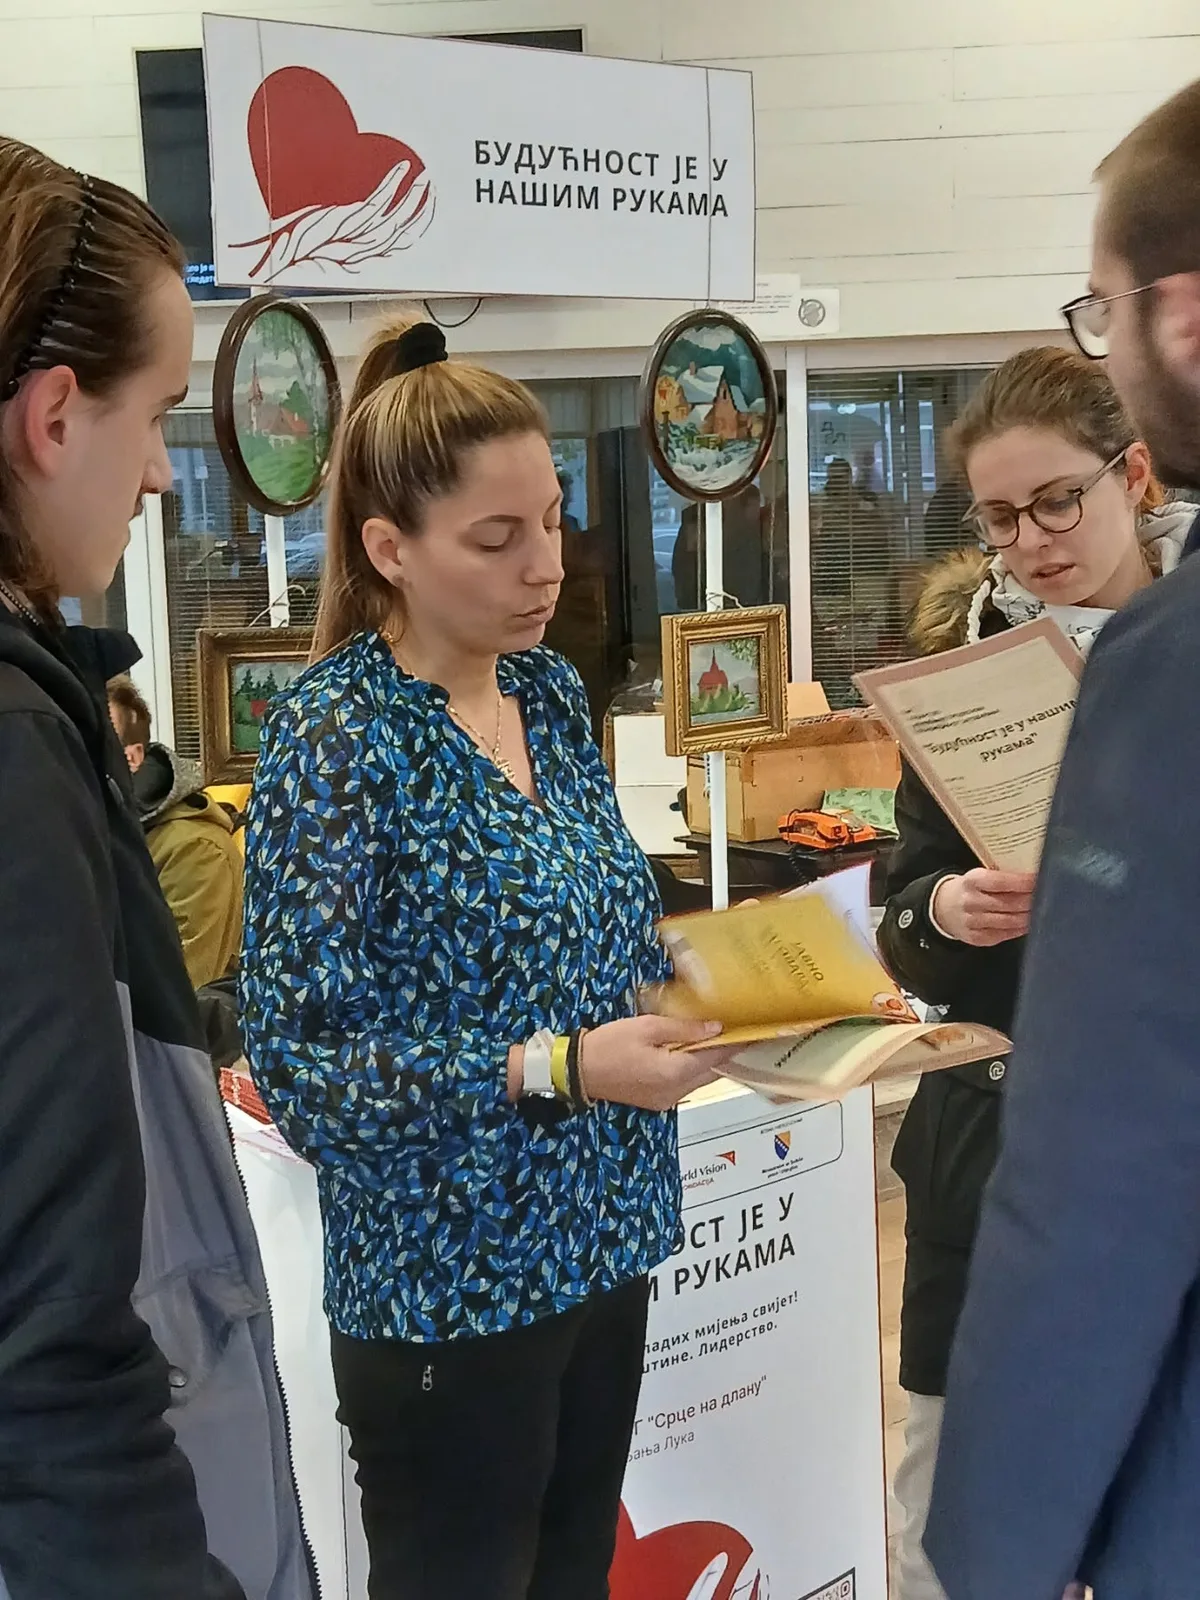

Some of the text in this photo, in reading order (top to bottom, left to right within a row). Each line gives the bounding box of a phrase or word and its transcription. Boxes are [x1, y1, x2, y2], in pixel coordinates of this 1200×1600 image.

[474, 140, 728, 184] БУДУЋНОСТ ЈЕ У
[475, 178, 728, 217] НАШИМ РУКАМА
[699, 1163, 727, 1176] Vision
[738, 1203, 764, 1242] ЈЕ
[778, 1192, 794, 1222] У
[674, 1233, 796, 1296] РУКАМА
[695, 1312, 749, 1339] мијења
[752, 1290, 798, 1319] свијет!
[698, 1321, 778, 1357] Лидерство.
[648, 1406, 696, 1429] "Срце
[700, 1398, 717, 1414] на
[721, 1375, 767, 1408] длану"
[664, 1431, 695, 1451] Лука
